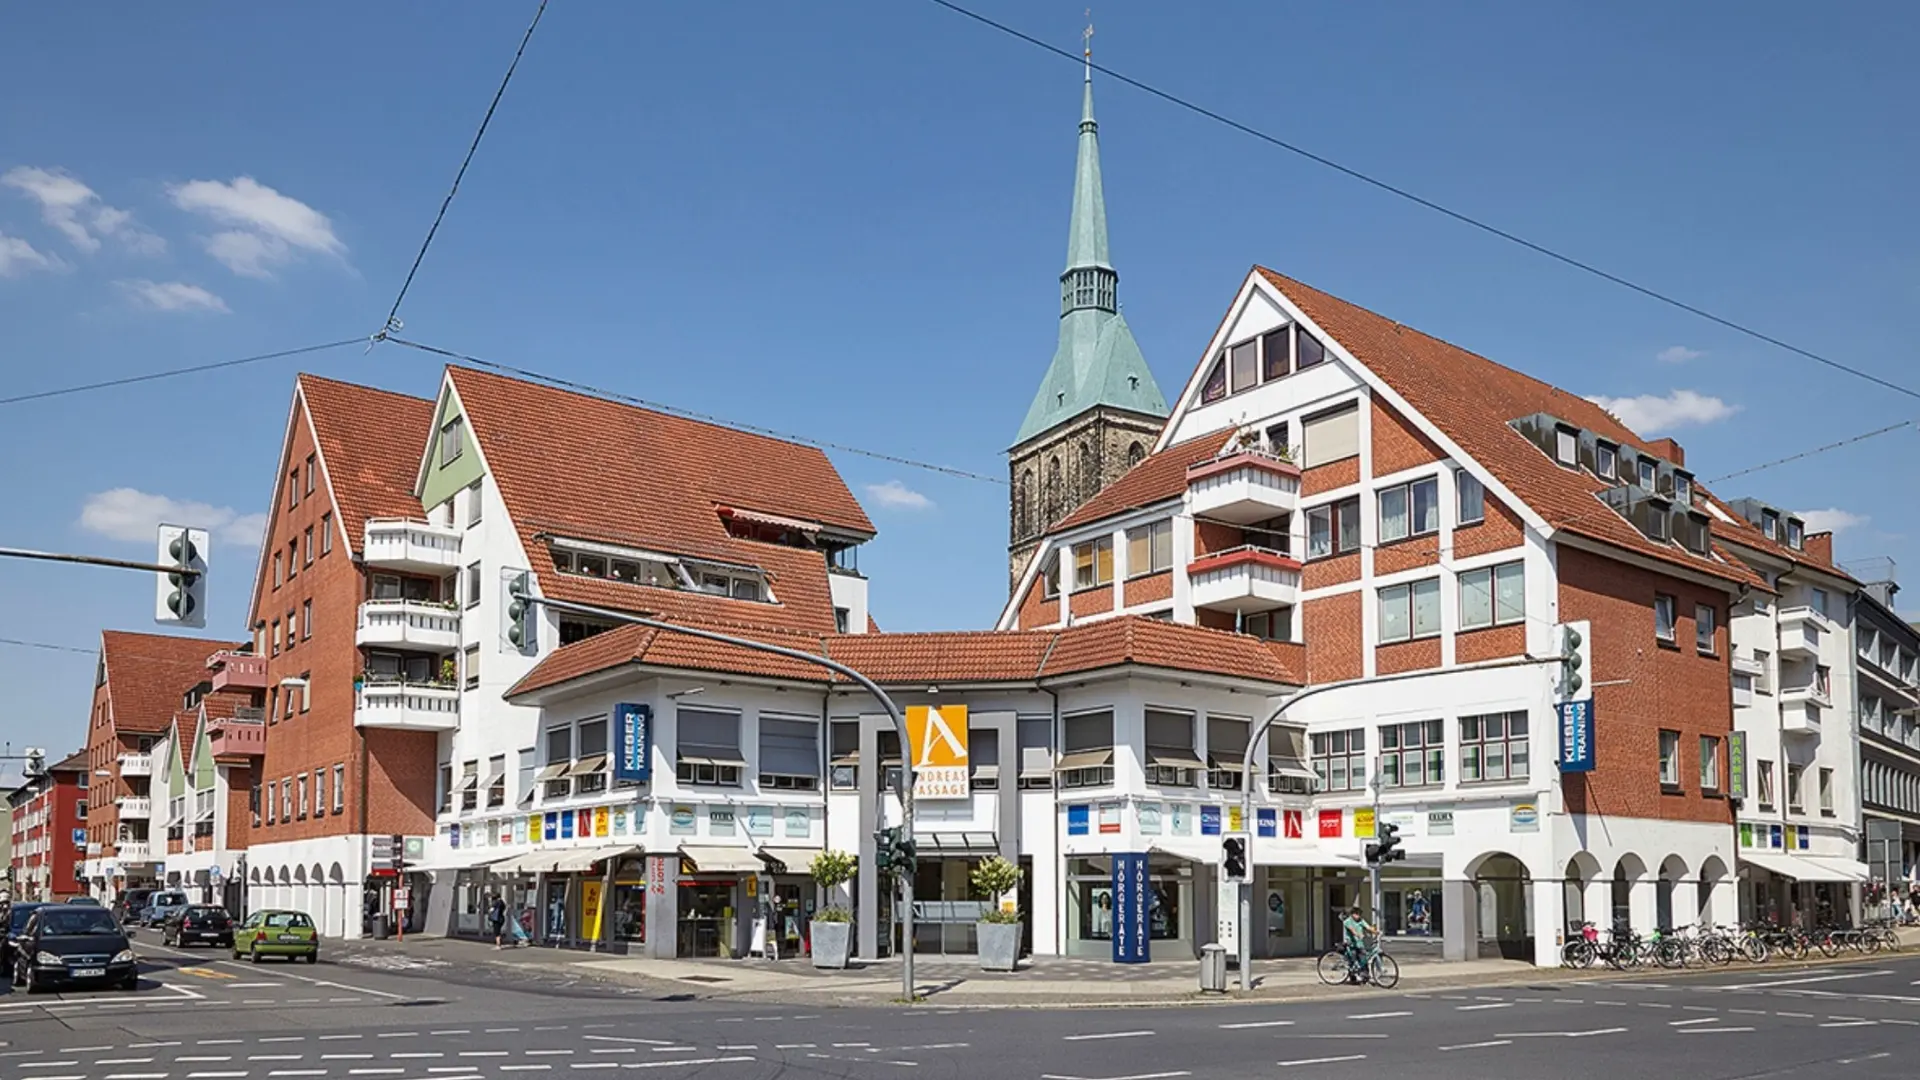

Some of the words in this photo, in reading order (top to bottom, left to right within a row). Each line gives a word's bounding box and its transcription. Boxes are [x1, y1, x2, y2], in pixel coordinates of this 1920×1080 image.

[637, 713, 646, 771] TRAINING
[1576, 702, 1587, 762] TRAINING
[914, 783, 966, 796] ASSAGE
